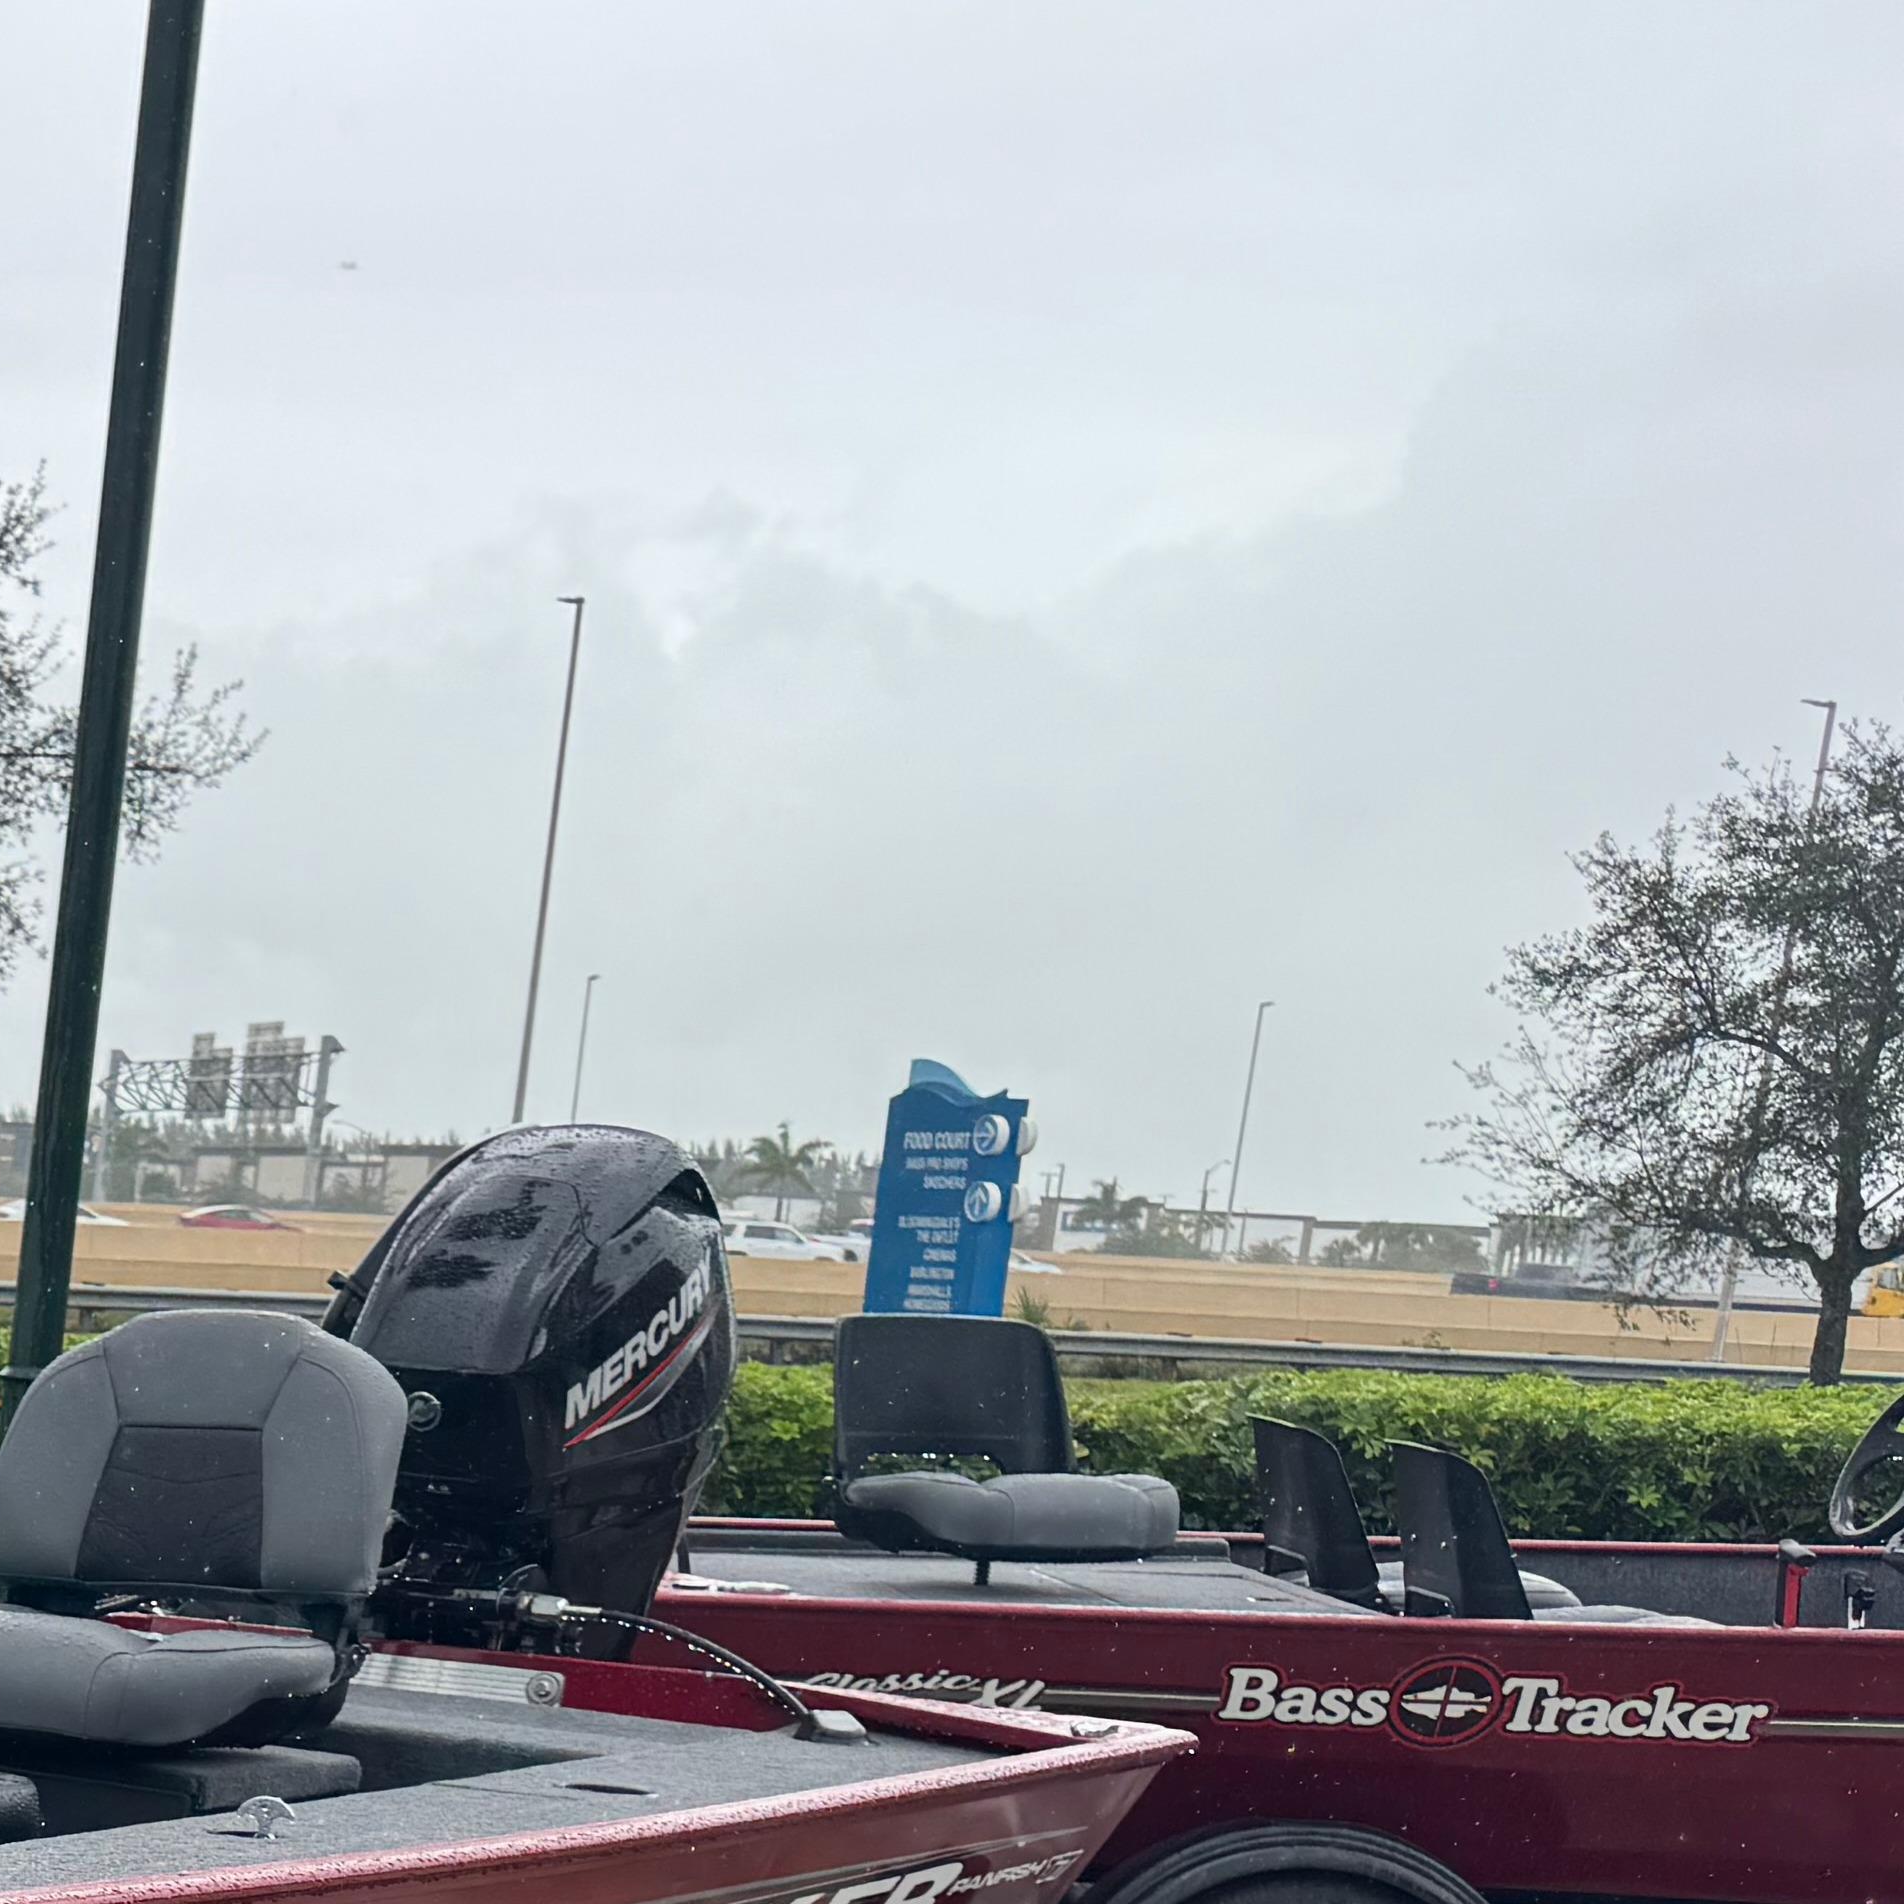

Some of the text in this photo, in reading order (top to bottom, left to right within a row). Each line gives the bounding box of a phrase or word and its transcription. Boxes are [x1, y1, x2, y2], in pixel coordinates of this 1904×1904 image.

[903, 1131, 971, 1150] FOOD COURT
[565, 1246, 711, 1430] MERCURY
[969, 1678, 1045, 1711] XL
[1218, 1667, 1769, 1742] Bass Tracker
